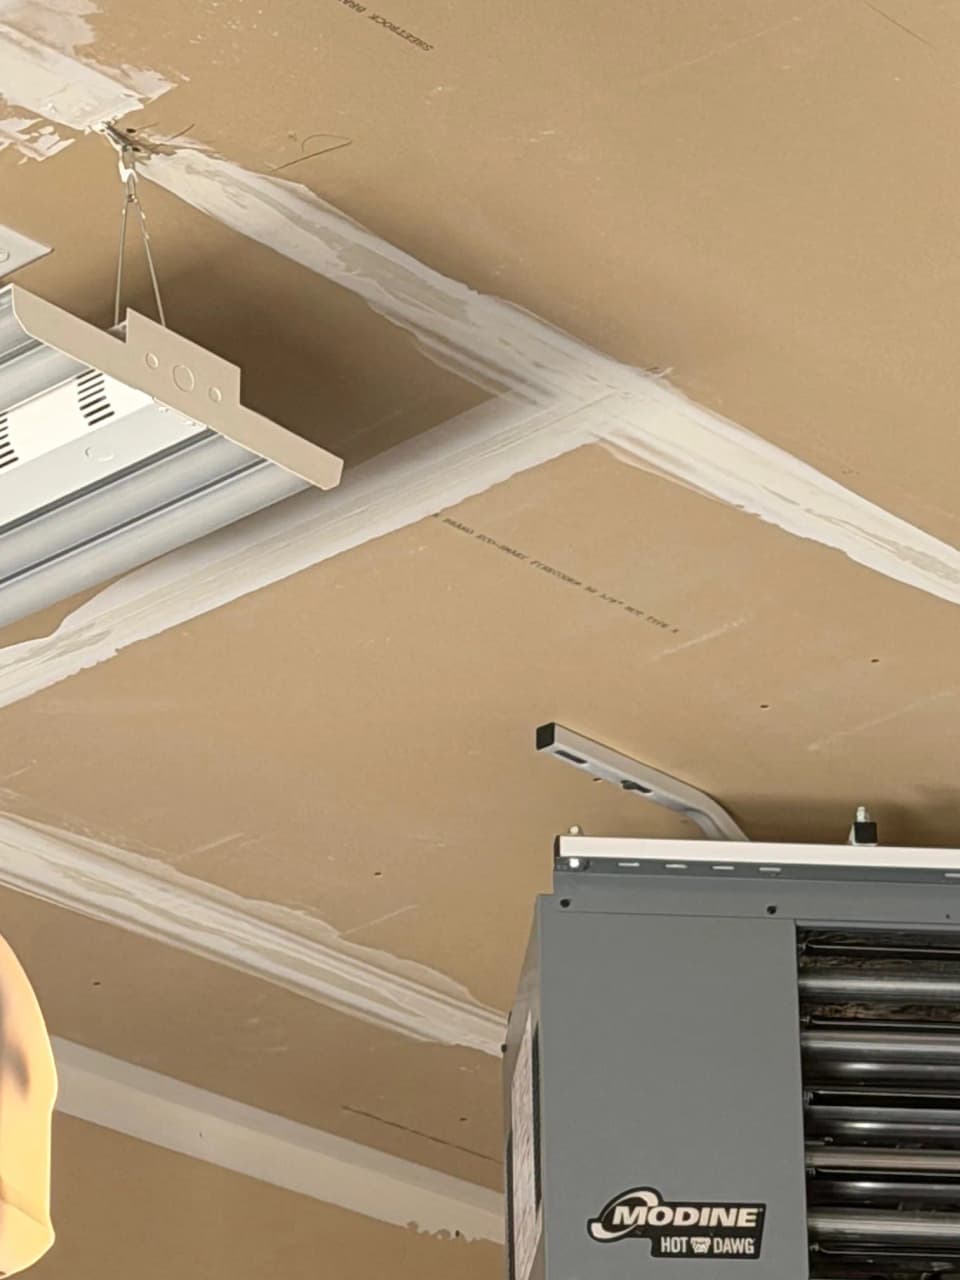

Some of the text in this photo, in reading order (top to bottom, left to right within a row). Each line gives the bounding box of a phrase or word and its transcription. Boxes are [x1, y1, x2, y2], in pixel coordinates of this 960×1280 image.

[612, 1205, 758, 1228] MODINE
[660, 1236, 754, 1255] HOT DAWG
